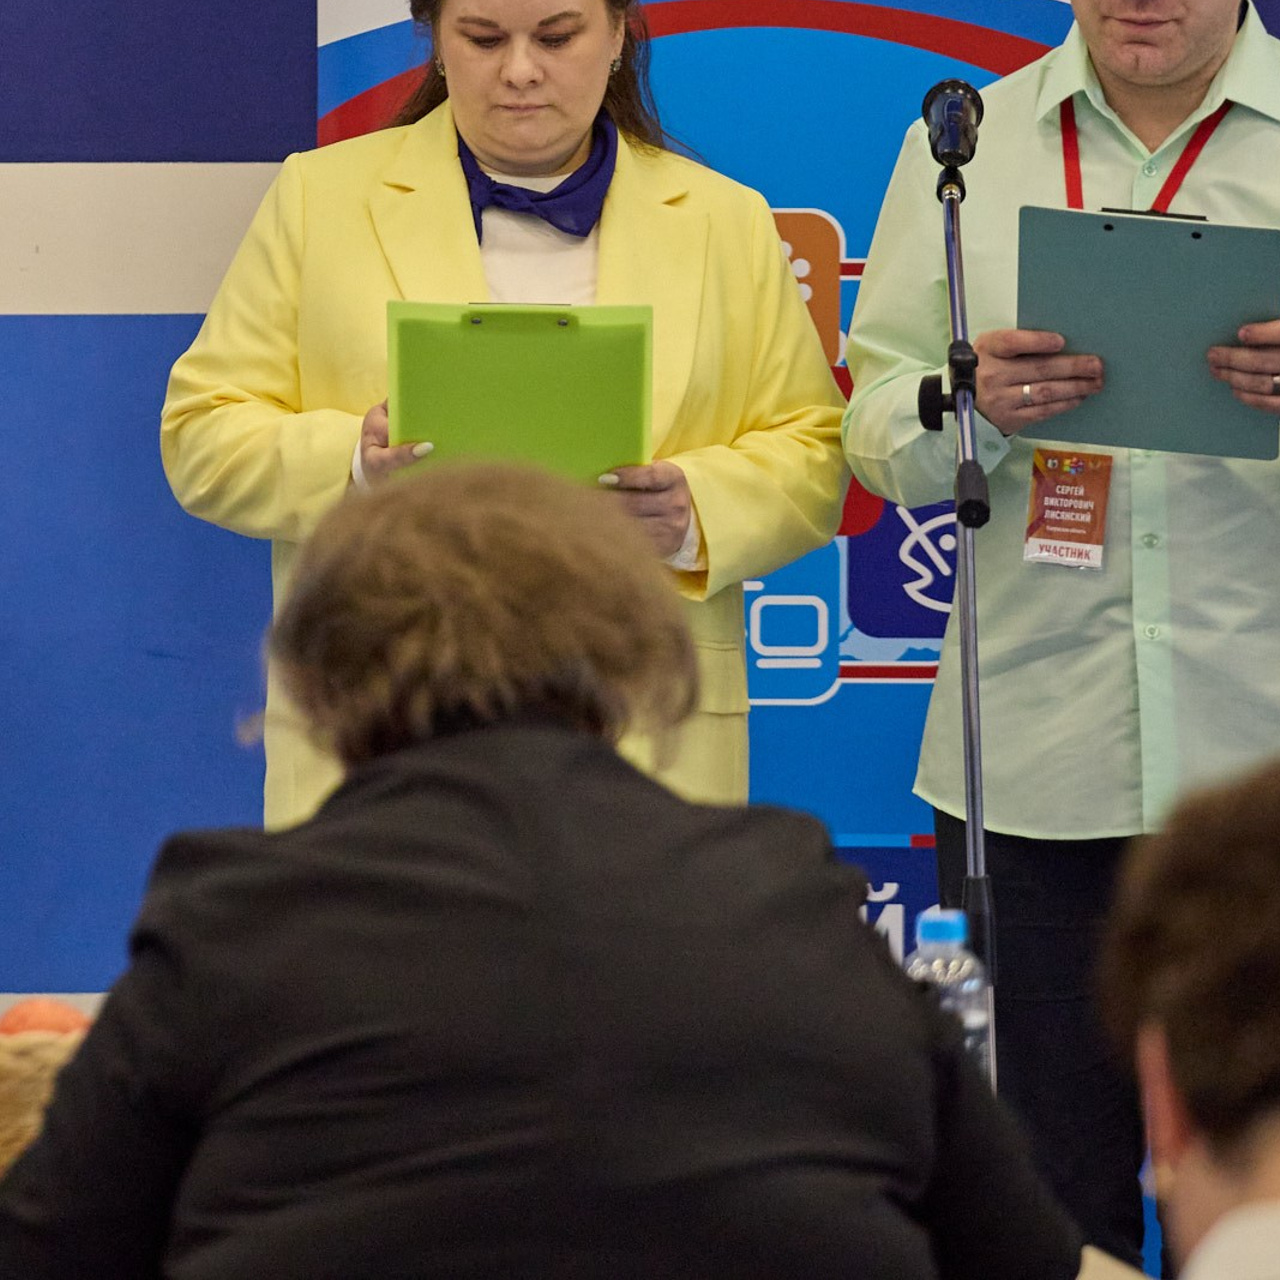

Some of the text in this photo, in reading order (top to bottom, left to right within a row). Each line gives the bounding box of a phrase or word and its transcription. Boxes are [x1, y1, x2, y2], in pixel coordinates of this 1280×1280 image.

[1055, 484, 1085, 496] СЕРГЕЙ
[1043, 496, 1095, 511] ВИКТОРОВИЧ
[1038, 543, 1091, 560] УЧАСТНИК
